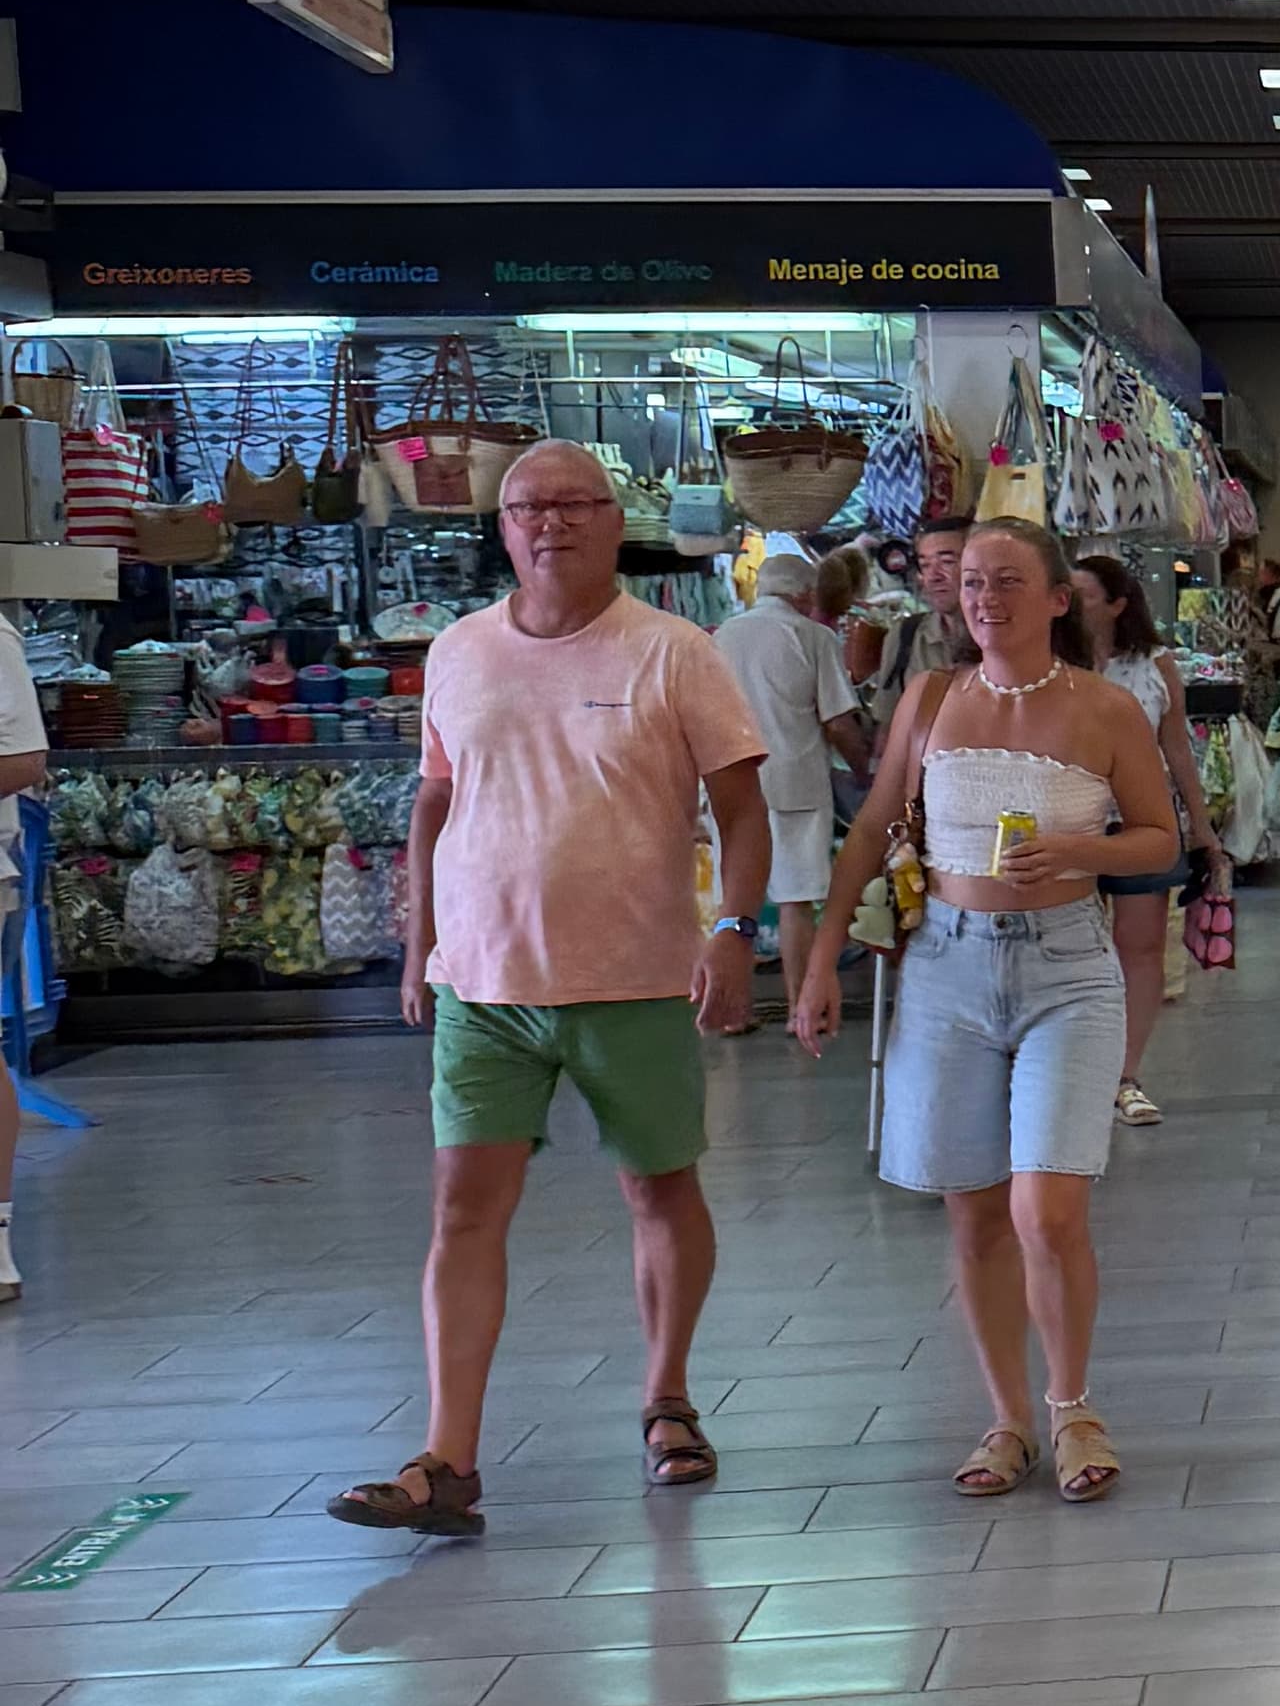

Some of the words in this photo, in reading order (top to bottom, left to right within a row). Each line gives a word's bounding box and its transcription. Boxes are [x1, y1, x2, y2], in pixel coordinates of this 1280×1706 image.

[82, 261, 252, 286] Greixoneres
[310, 260, 440, 284] Cerámica
[495, 260, 593, 283] Madera
[601, 260, 635, 282] de
[642, 260, 713, 283] Olivo
[768, 258, 864, 285] Menaje
[872, 258, 904, 281] de
[911, 258, 1000, 281] cocina
